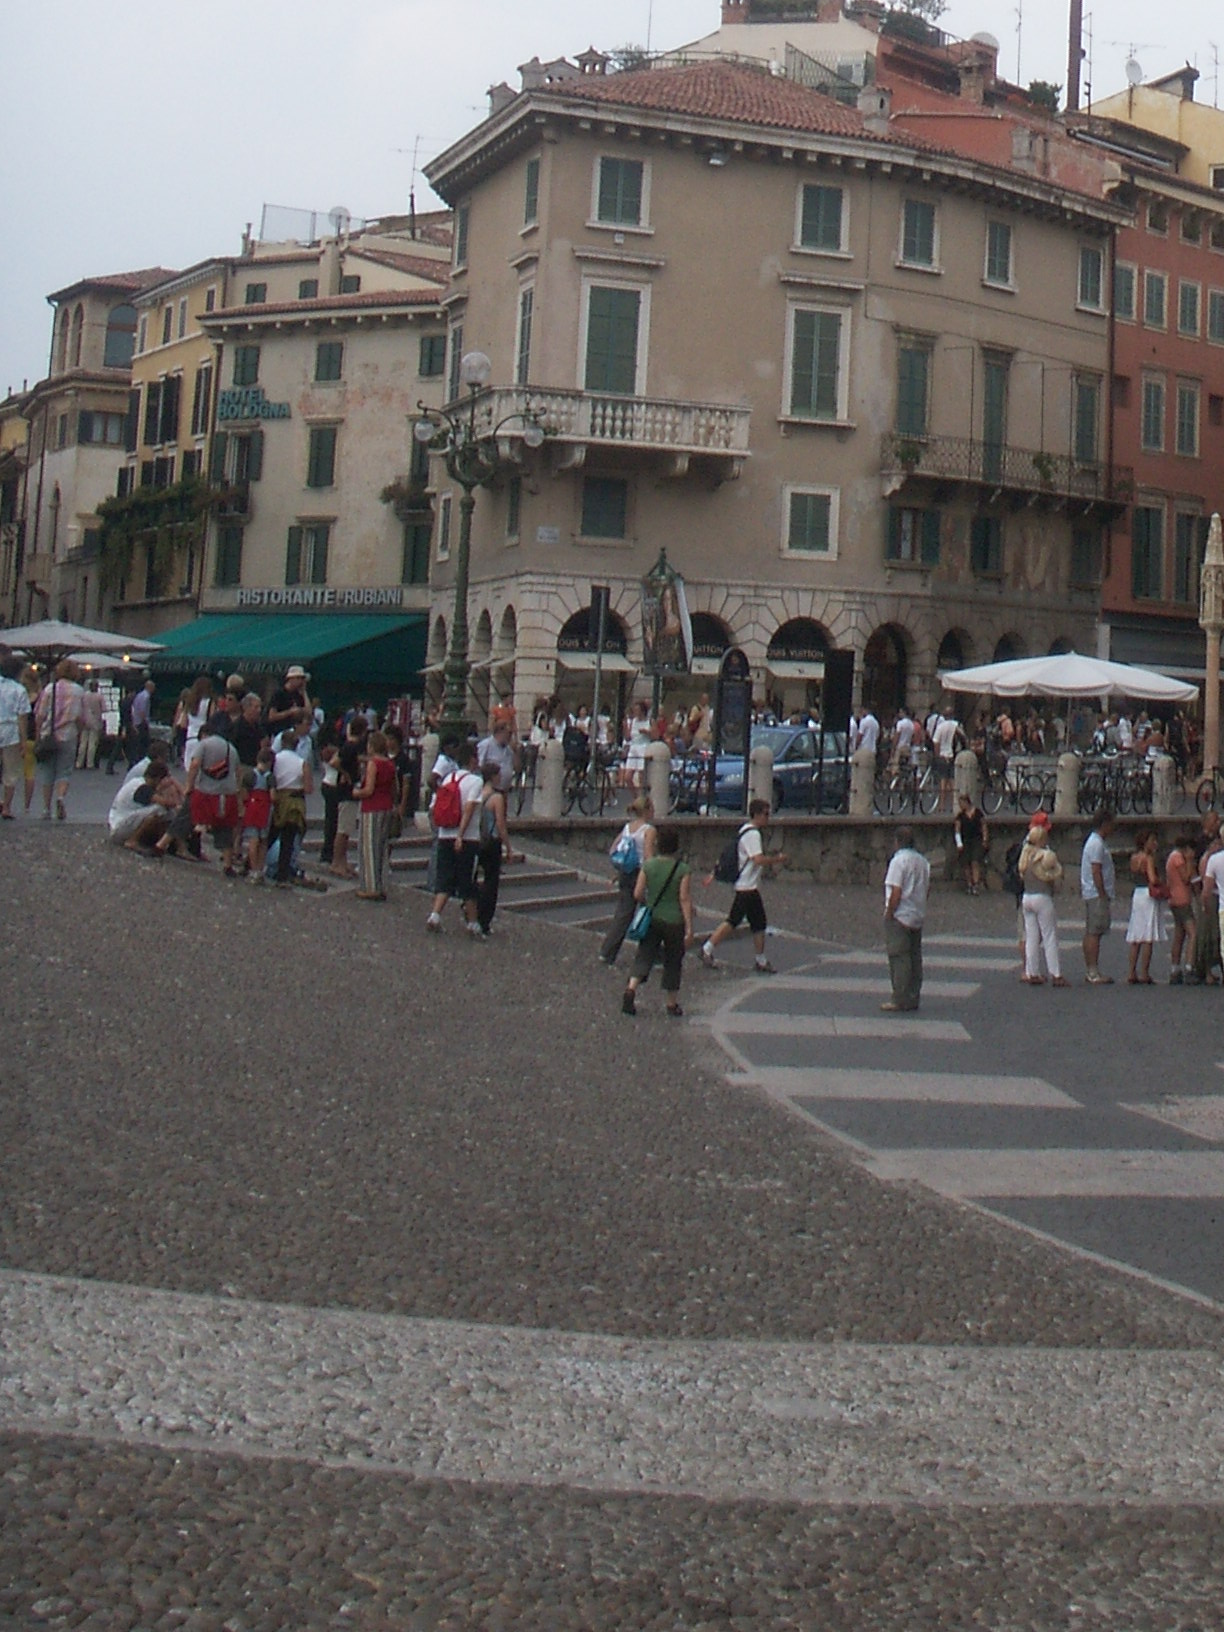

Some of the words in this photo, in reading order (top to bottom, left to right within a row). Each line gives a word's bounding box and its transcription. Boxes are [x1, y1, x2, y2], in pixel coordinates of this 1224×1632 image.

[218, 387, 265, 405] HOTEL
[217, 401, 292, 420] BOLOGNA
[237, 588, 336, 605] RISTORANTE
[344, 588, 402, 605] RUBIANI
[149, 660, 211, 672] ISTORANTE
